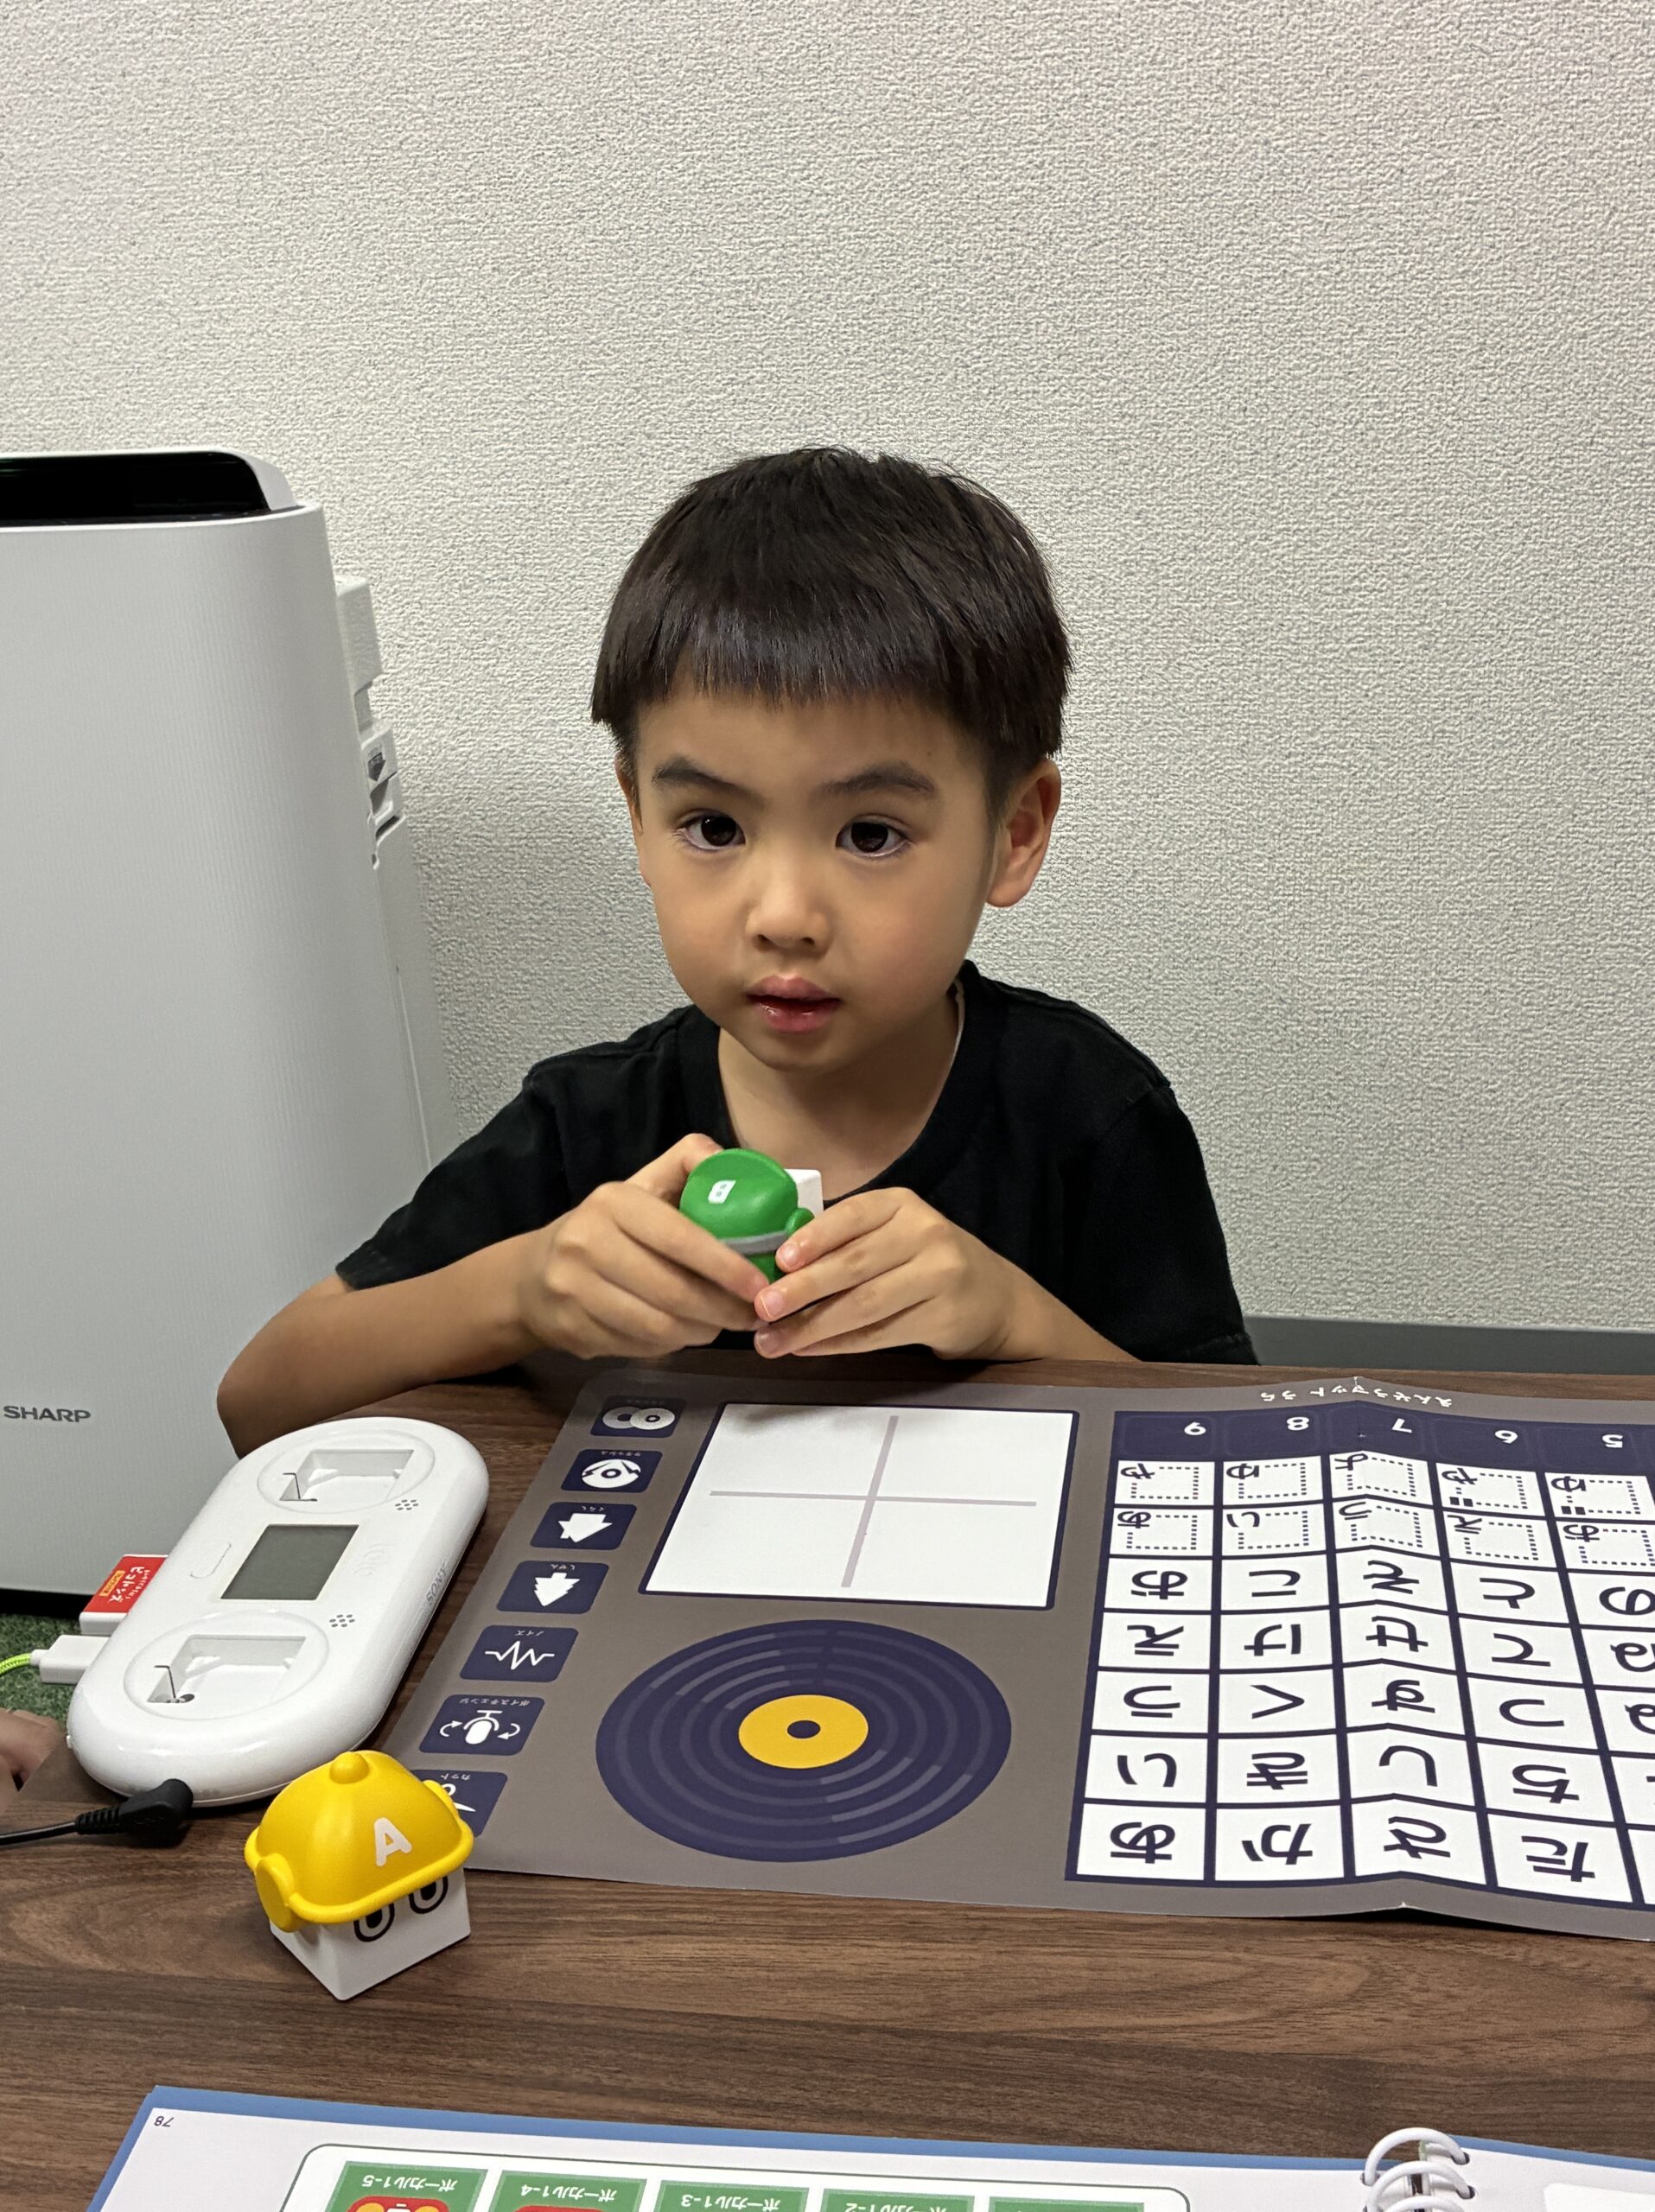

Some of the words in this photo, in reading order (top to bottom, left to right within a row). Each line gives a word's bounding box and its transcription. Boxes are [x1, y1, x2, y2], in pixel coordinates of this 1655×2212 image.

[1261, 1390, 1296, 1402] うら
[1310, 1385, 1452, 1408] えんそうマット
[3, 1405, 91, 1422] SHARP
[1184, 1422, 1206, 1435] 9
[1287, 1417, 1309, 1430] 8
[1392, 1418, 1412, 1433] 7
[1495, 1430, 1518, 1444] 6
[1602, 1434, 1623, 1448] 5
[1132, 1571, 1187, 1599] お
[1249, 1570, 1301, 1597] こ
[1364, 1560, 1420, 1594] そ
[1480, 1578, 1535, 1609] て
[1600, 1587, 1655, 1615] の
[1127, 1625, 1183, 1656] え
[1244, 1624, 1301, 1656] け
[1366, 1616, 1428, 1652] せ
[1492, 1633, 1550, 1667] と
[460, 1698, 531, 1707] ボイスチェンジ
[1123, 1686, 1180, 1718] う
[1251, 1684, 1304, 1719] く
[1372, 1680, 1435, 1713] す
[1499, 1700, 1564, 1726] つ
[1117, 1753, 1176, 1787] い
[1247, 1752, 1308, 1789] き
[1379, 1745, 1437, 1787] し
[1512, 1764, 1579, 1803] ち
[374, 1817, 411, 1866] A
[1111, 1822, 1174, 1864] あ
[1242, 1824, 1312, 1865] か
[1384, 1816, 1450, 1859] さ
[1522, 1836, 1595, 1882] た
[155, 2116, 174, 2127] 78
